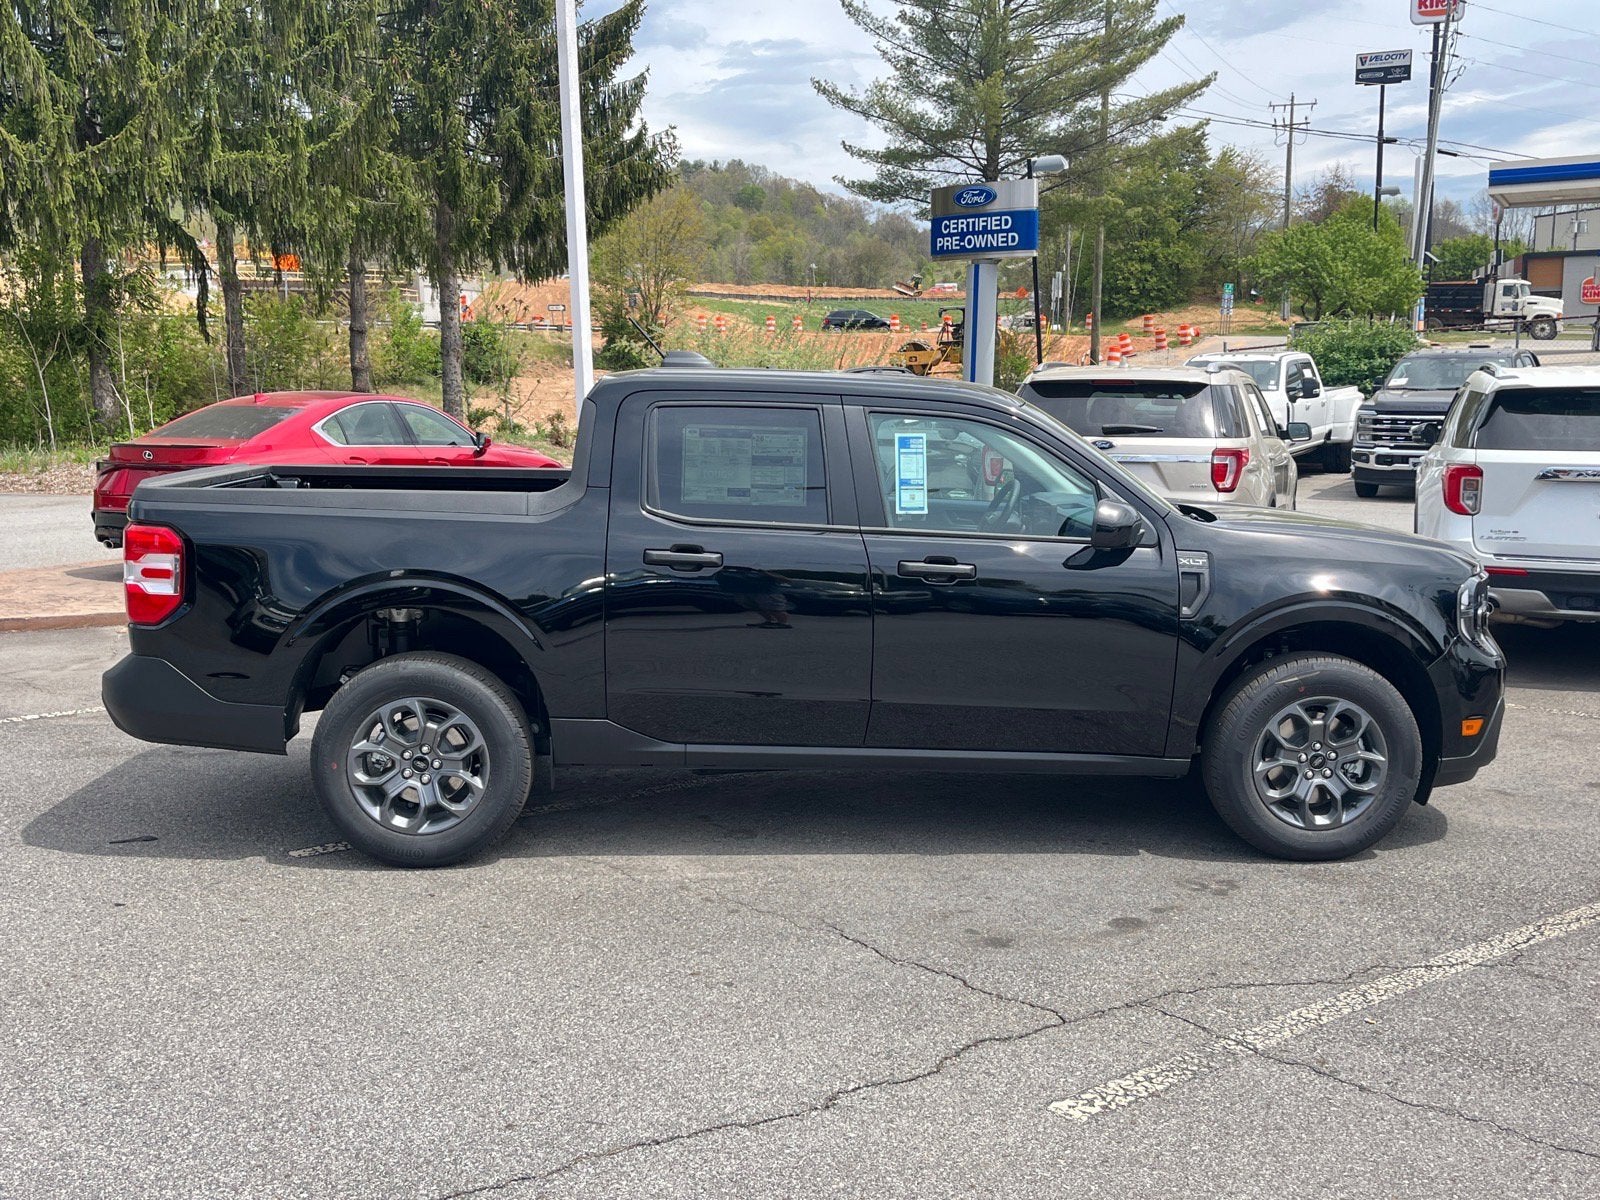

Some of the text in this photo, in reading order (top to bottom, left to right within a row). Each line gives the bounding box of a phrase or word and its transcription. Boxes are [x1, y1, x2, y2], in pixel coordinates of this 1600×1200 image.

[1368, 52, 1409, 62] VELOCITY
[960, 190, 987, 204] Ford
[941, 215, 1012, 234] CERTIFIED
[936, 232, 1019, 251] PRE-OWNED
[1178, 557, 1207, 565] XLT
